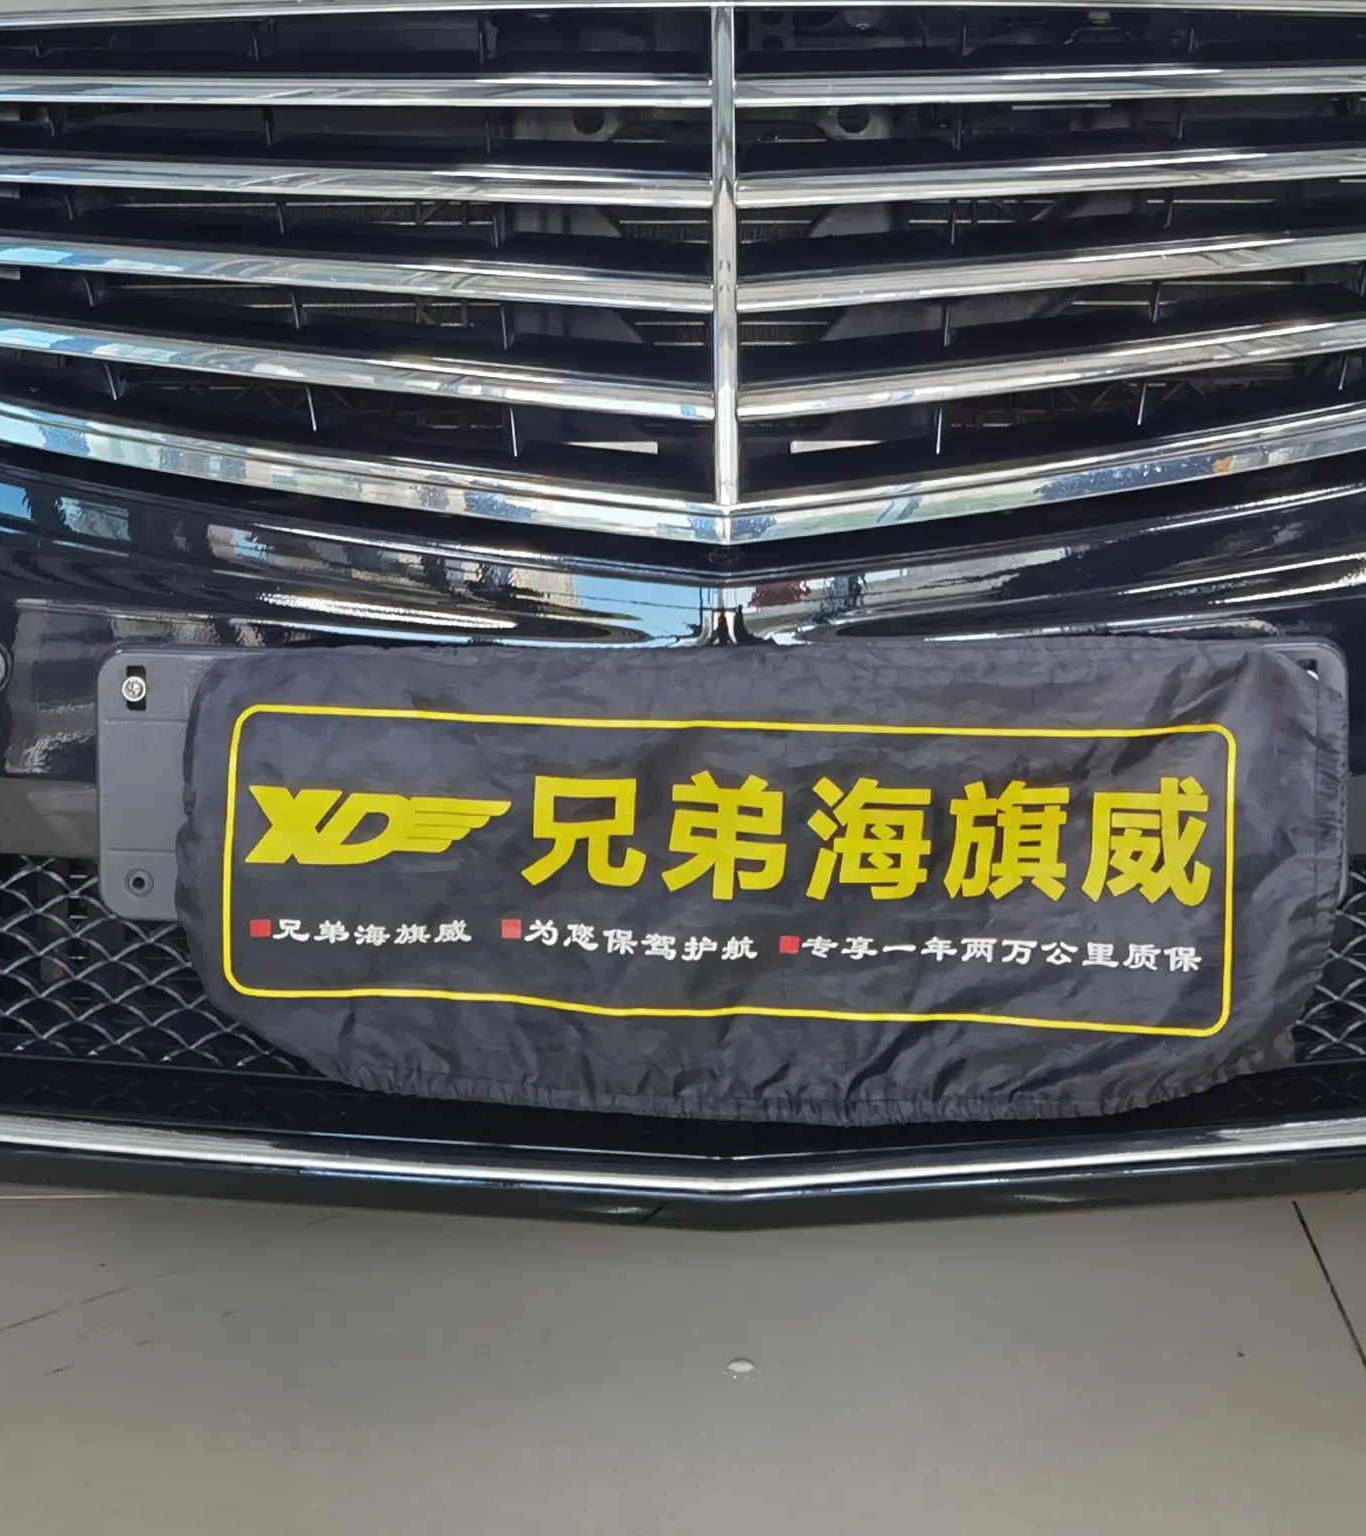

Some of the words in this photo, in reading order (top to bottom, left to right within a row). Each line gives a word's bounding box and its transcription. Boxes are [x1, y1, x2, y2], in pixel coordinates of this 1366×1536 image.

[522, 770, 1211, 906] 兄弟海旗威
[272, 919, 472, 946] 兄弟海旗威
[524, 919, 758, 961] 为您保驾护航
[801, 935, 1202, 972] 专享一年两万公里质保
